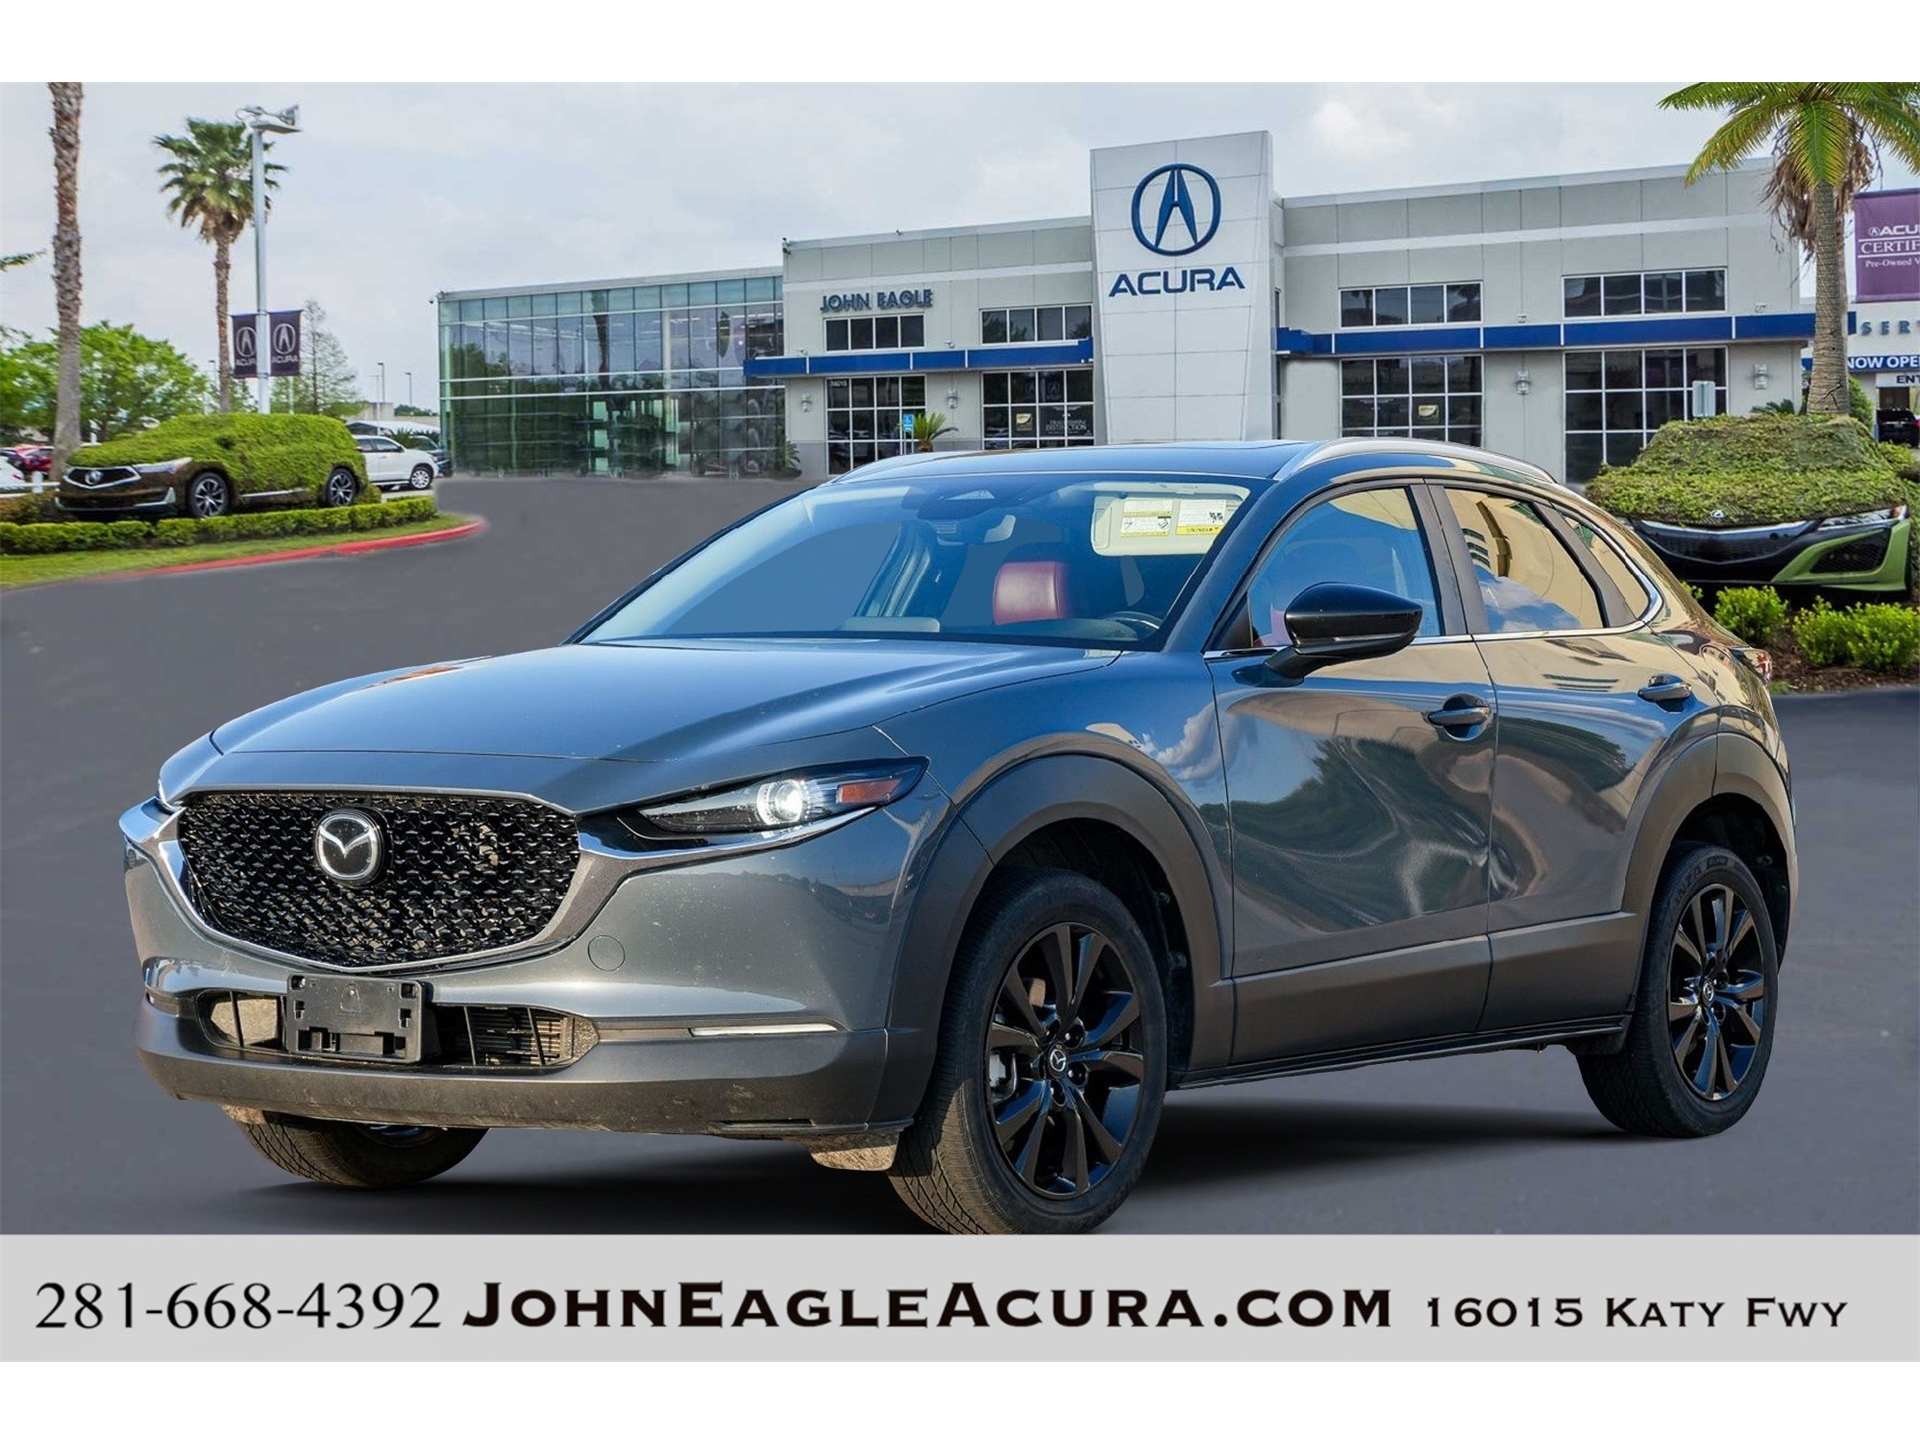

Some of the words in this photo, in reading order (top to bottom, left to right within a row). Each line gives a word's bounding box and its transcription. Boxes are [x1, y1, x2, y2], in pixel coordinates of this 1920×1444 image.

[1879, 224, 1920, 236] ACU
[1108, 266, 1246, 298] ACURA
[820, 292, 871, 313] JOHN
[876, 289, 933, 310] EAGLE
[1860, 320, 1920, 336] SER
[1847, 357, 1884, 369] NOW
[1886, 356, 1920, 368] OPE
